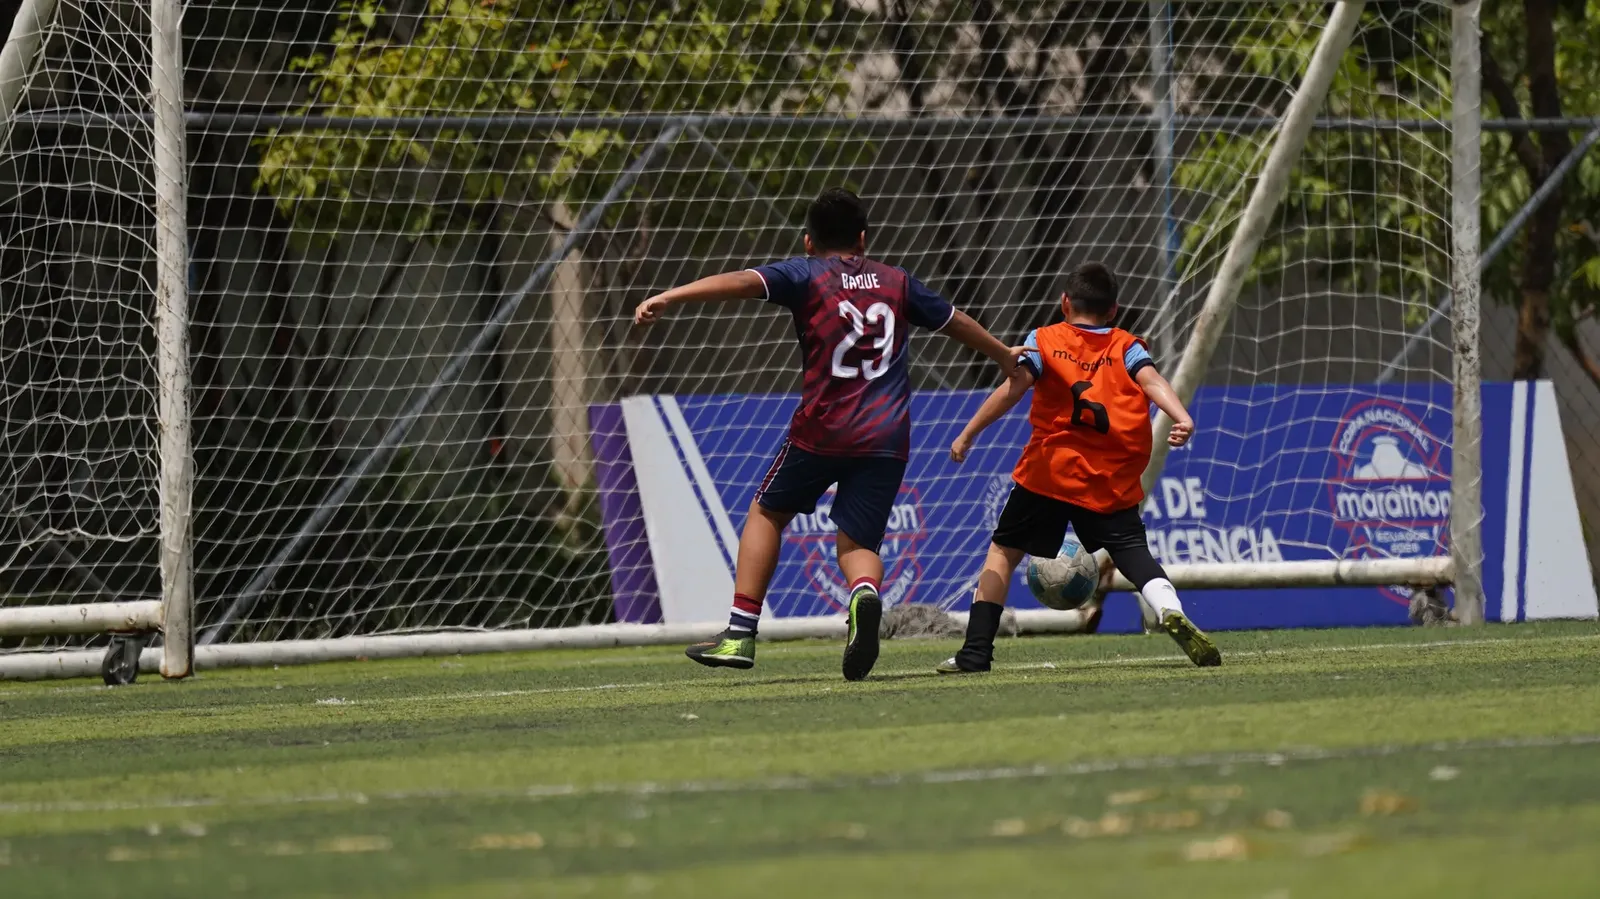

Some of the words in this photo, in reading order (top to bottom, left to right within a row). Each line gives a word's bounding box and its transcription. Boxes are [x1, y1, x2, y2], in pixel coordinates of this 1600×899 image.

[841, 272, 880, 289] BAQUE
[832, 300, 895, 380] 23
[1070, 380, 1110, 434] 6
[1161, 476, 1207, 519] DE
